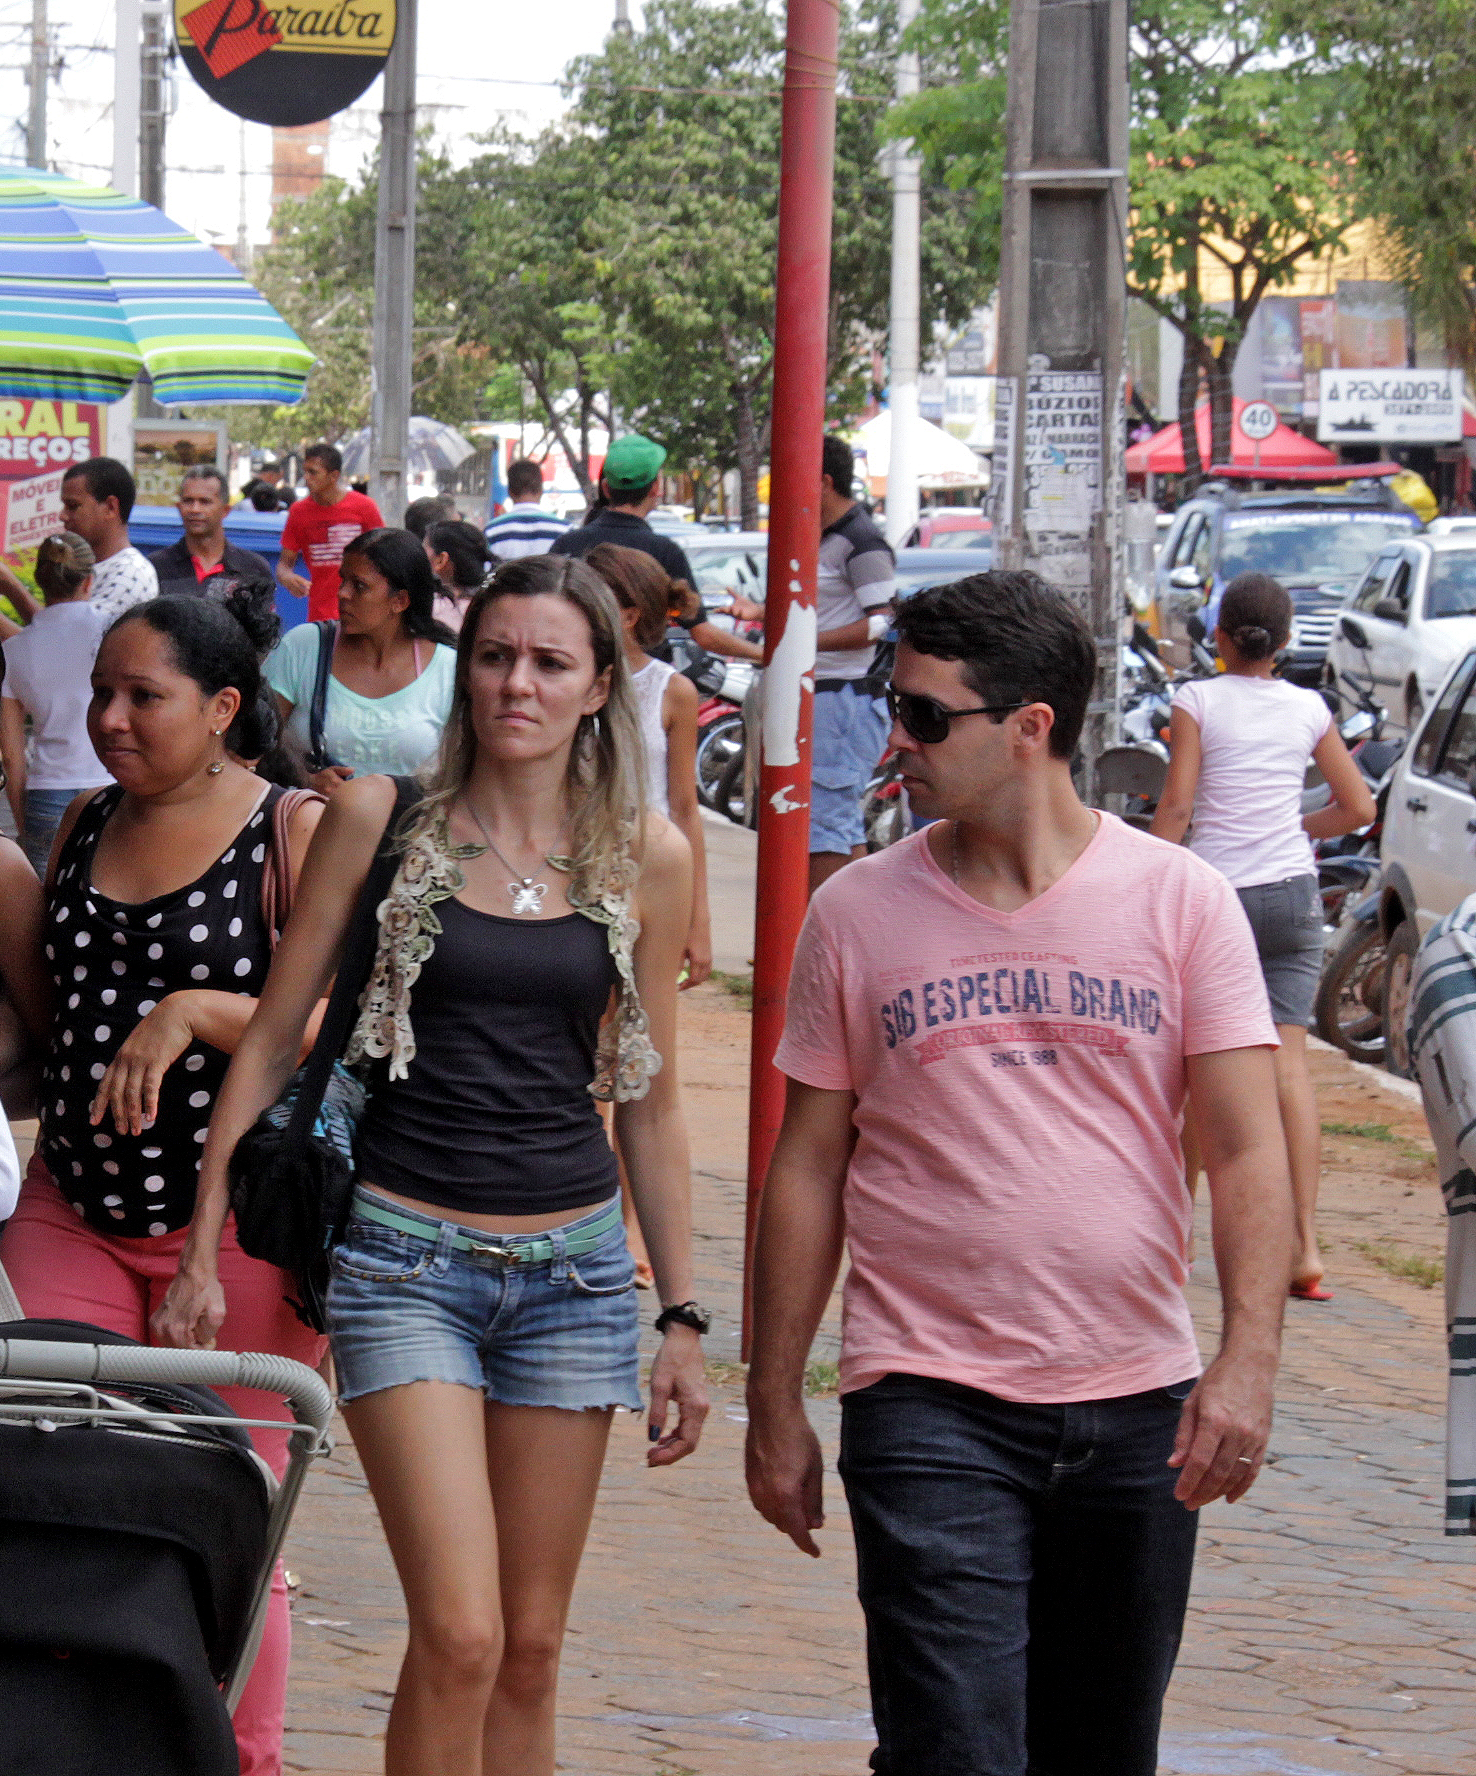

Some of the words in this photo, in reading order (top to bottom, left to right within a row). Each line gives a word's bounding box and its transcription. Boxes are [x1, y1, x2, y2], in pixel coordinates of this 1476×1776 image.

[1347, 381, 1452, 401] PESCADORA
[1245, 409, 1272, 426] 40
[36, 499, 46, 512] E
[923, 968, 1061, 1028] ESPECIAL
[1069, 970, 1161, 1035] BRAND
